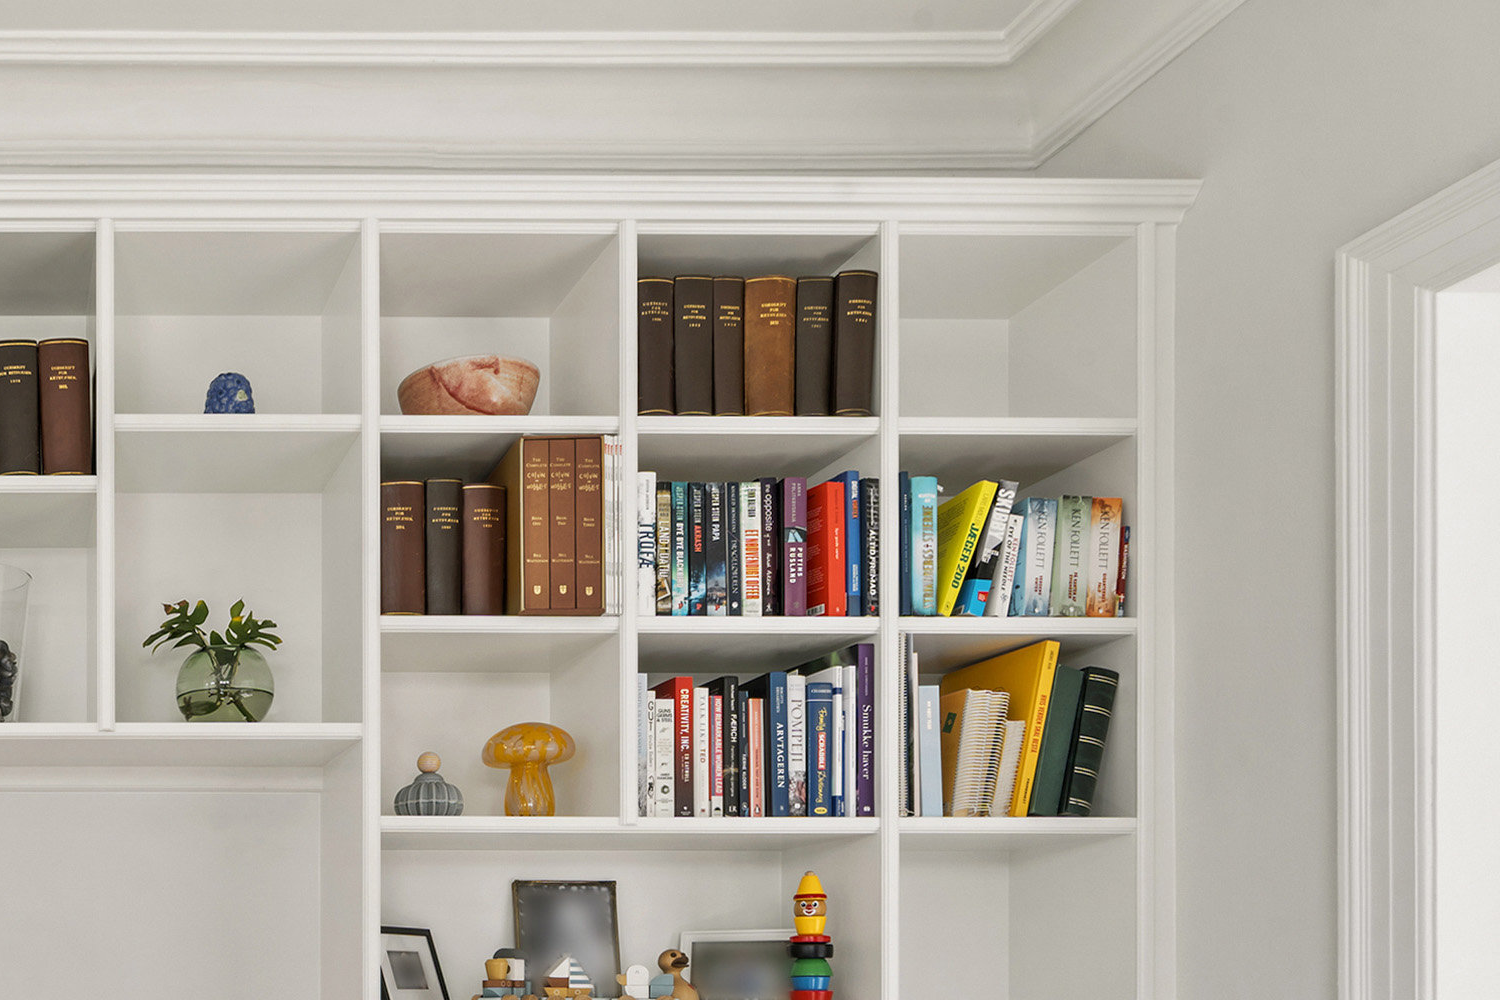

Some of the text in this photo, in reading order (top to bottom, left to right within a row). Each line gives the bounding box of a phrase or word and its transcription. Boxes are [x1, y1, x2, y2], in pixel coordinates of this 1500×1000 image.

[676, 522, 684, 535] BYE
[694, 509, 702, 523] STEIN
[712, 507, 720, 522] STEIN
[763, 494, 775, 532] opposite
[638, 522, 656, 570] TROFÆ
[658, 521, 670, 544] LAND
[676, 537, 684, 550] BYE
[694, 525, 702, 553] AKRASH
[712, 524, 720, 541] PAPA
[745, 529, 759, 537] ET
[1007, 540, 1012, 549] OF
[1035, 531, 1046, 570] FOLLETT
[1069, 508, 1082, 568] KEN FOLLETT
[1098, 511, 1111, 570] KEN FOLLETT
[676, 551, 684, 588] BLACKBIRD
[869, 556, 877, 596] FREMAD
[951, 522, 980, 609] JÆGER 200
[1008, 552, 1017, 582] FOLLETT
[1121, 544, 1129, 580] WASHINGTON
[746, 580, 760, 600] OFFER
[680, 688, 690, 753] CREATIVITY, INC.
[730, 714, 738, 743] FÆRCH
[790, 699, 804, 763] POMPEJI
[862, 704, 872, 746] Smukke
[715, 698, 723, 794] HOW REMARKABLE WOMEN LEAD
[776, 722, 785, 788] ARVTAGEREN
[863, 750, 872, 781] haver
